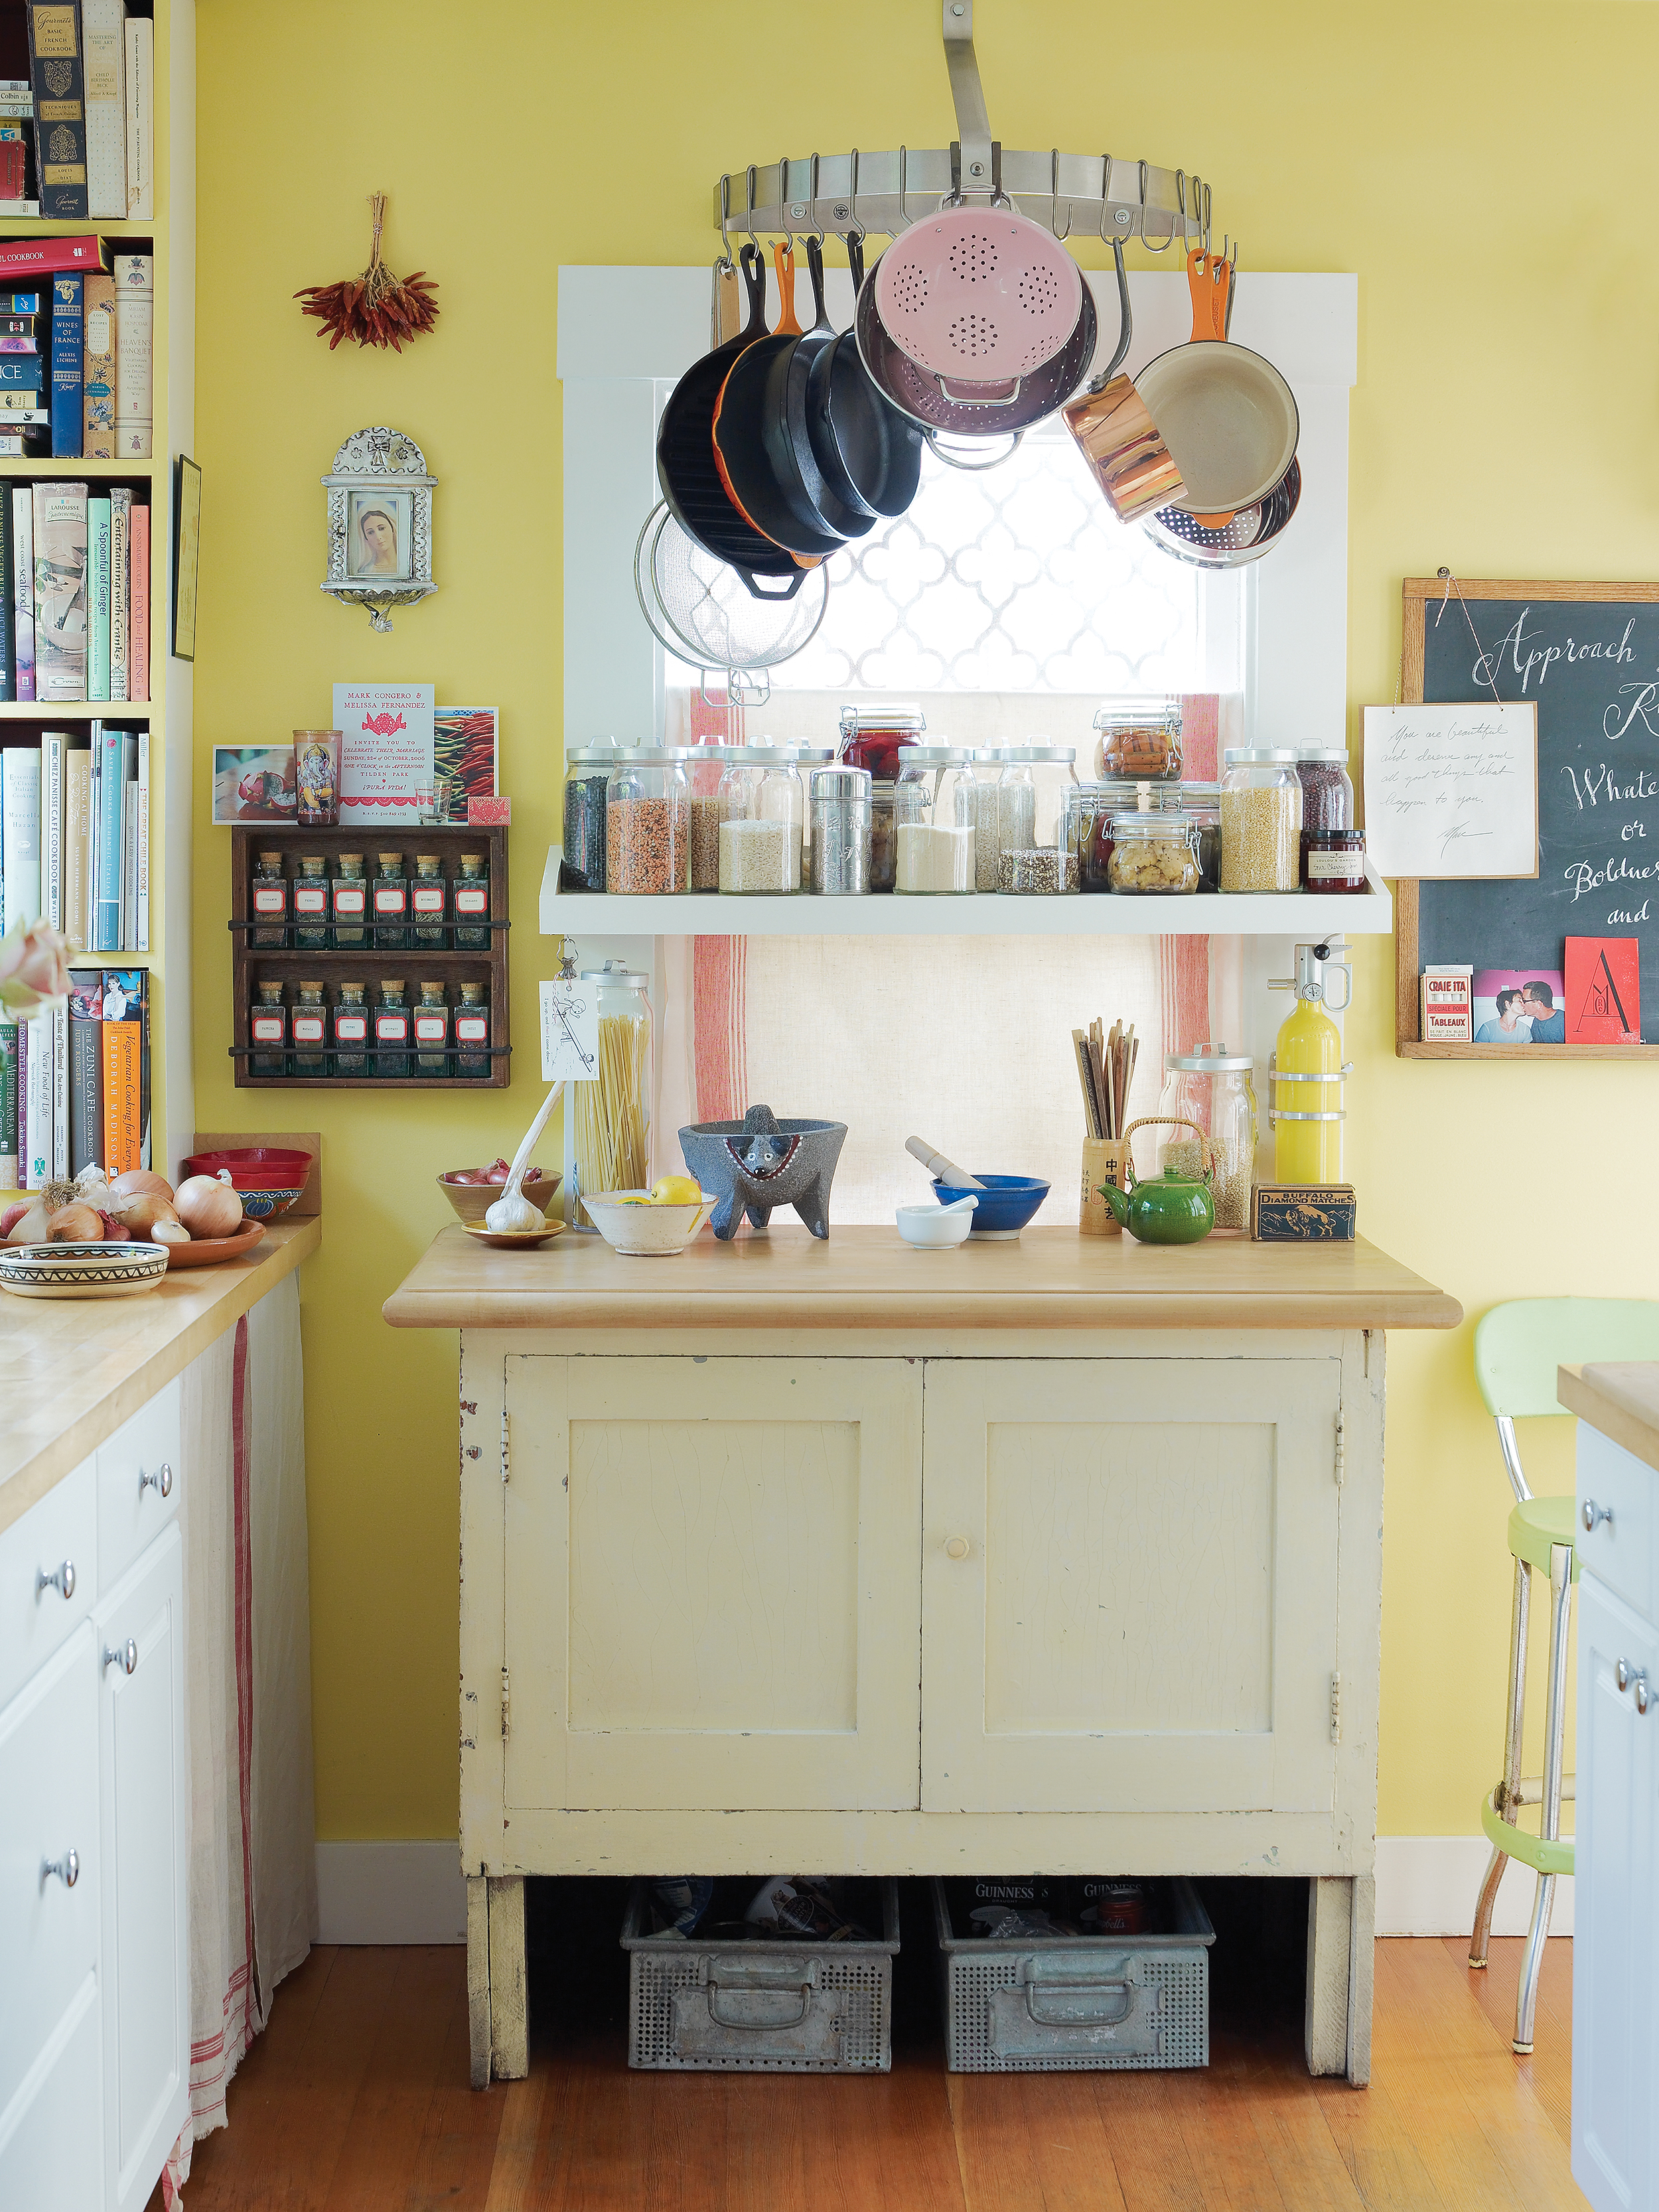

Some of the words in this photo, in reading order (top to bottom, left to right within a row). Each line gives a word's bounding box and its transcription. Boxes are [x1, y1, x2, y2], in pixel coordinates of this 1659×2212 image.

[7, 251, 44, 262] COOKBOOK
[98, 531, 108, 572] Spoonful
[112, 516, 124, 588] Entertaining
[19, 569, 31, 608] seafood
[100, 575, 108, 584] of
[98, 586, 108, 616] Ginger
[114, 590, 124, 615] with
[135, 594, 143, 624] FOOD
[135, 637, 143, 683] HEALING
[1472, 606, 1637, 693] Approach
[1388, 725, 1419, 753] You
[1447, 722, 1508, 740] beautiful
[1380, 749, 1408, 762] and
[1415, 748, 1460, 762] deserve
[1464, 753, 1485, 768] any
[1381, 771, 1398, 783] all
[1404, 772, 1430, 788] good
[1431, 764, 1475, 782] things
[1475, 762, 1515, 776] that
[1380, 792, 1426, 813] happen
[1435, 792, 1447, 804] to
[1455, 795, 1484, 809] you.
[1621, 820, 1647, 841] or
[1327, 863, 1346, 872] Cherry
[1607, 899, 1650, 925] and
[1429, 981, 1452, 992] CRAIE
[1429, 1016, 1467, 1026] TABLEAUX
[86, 1046, 96, 1077] ZUNI
[123, 1036, 135, 1081] Vegetarian
[7, 1063, 17, 1135] MEDITERRANEAN
[86, 1080, 96, 1113] CAFE
[122, 1084, 135, 1121] Cooking
[40, 1103, 50, 1118] Life
[122, 1121, 135, 1136] for
[1262, 1195, 1309, 1204] DIAMOND
[1310, 1195, 1354, 1204] MATCHES
[975, 1883, 1034, 1899] GUINNESS
[793, 1901, 806, 1916] LIVER
